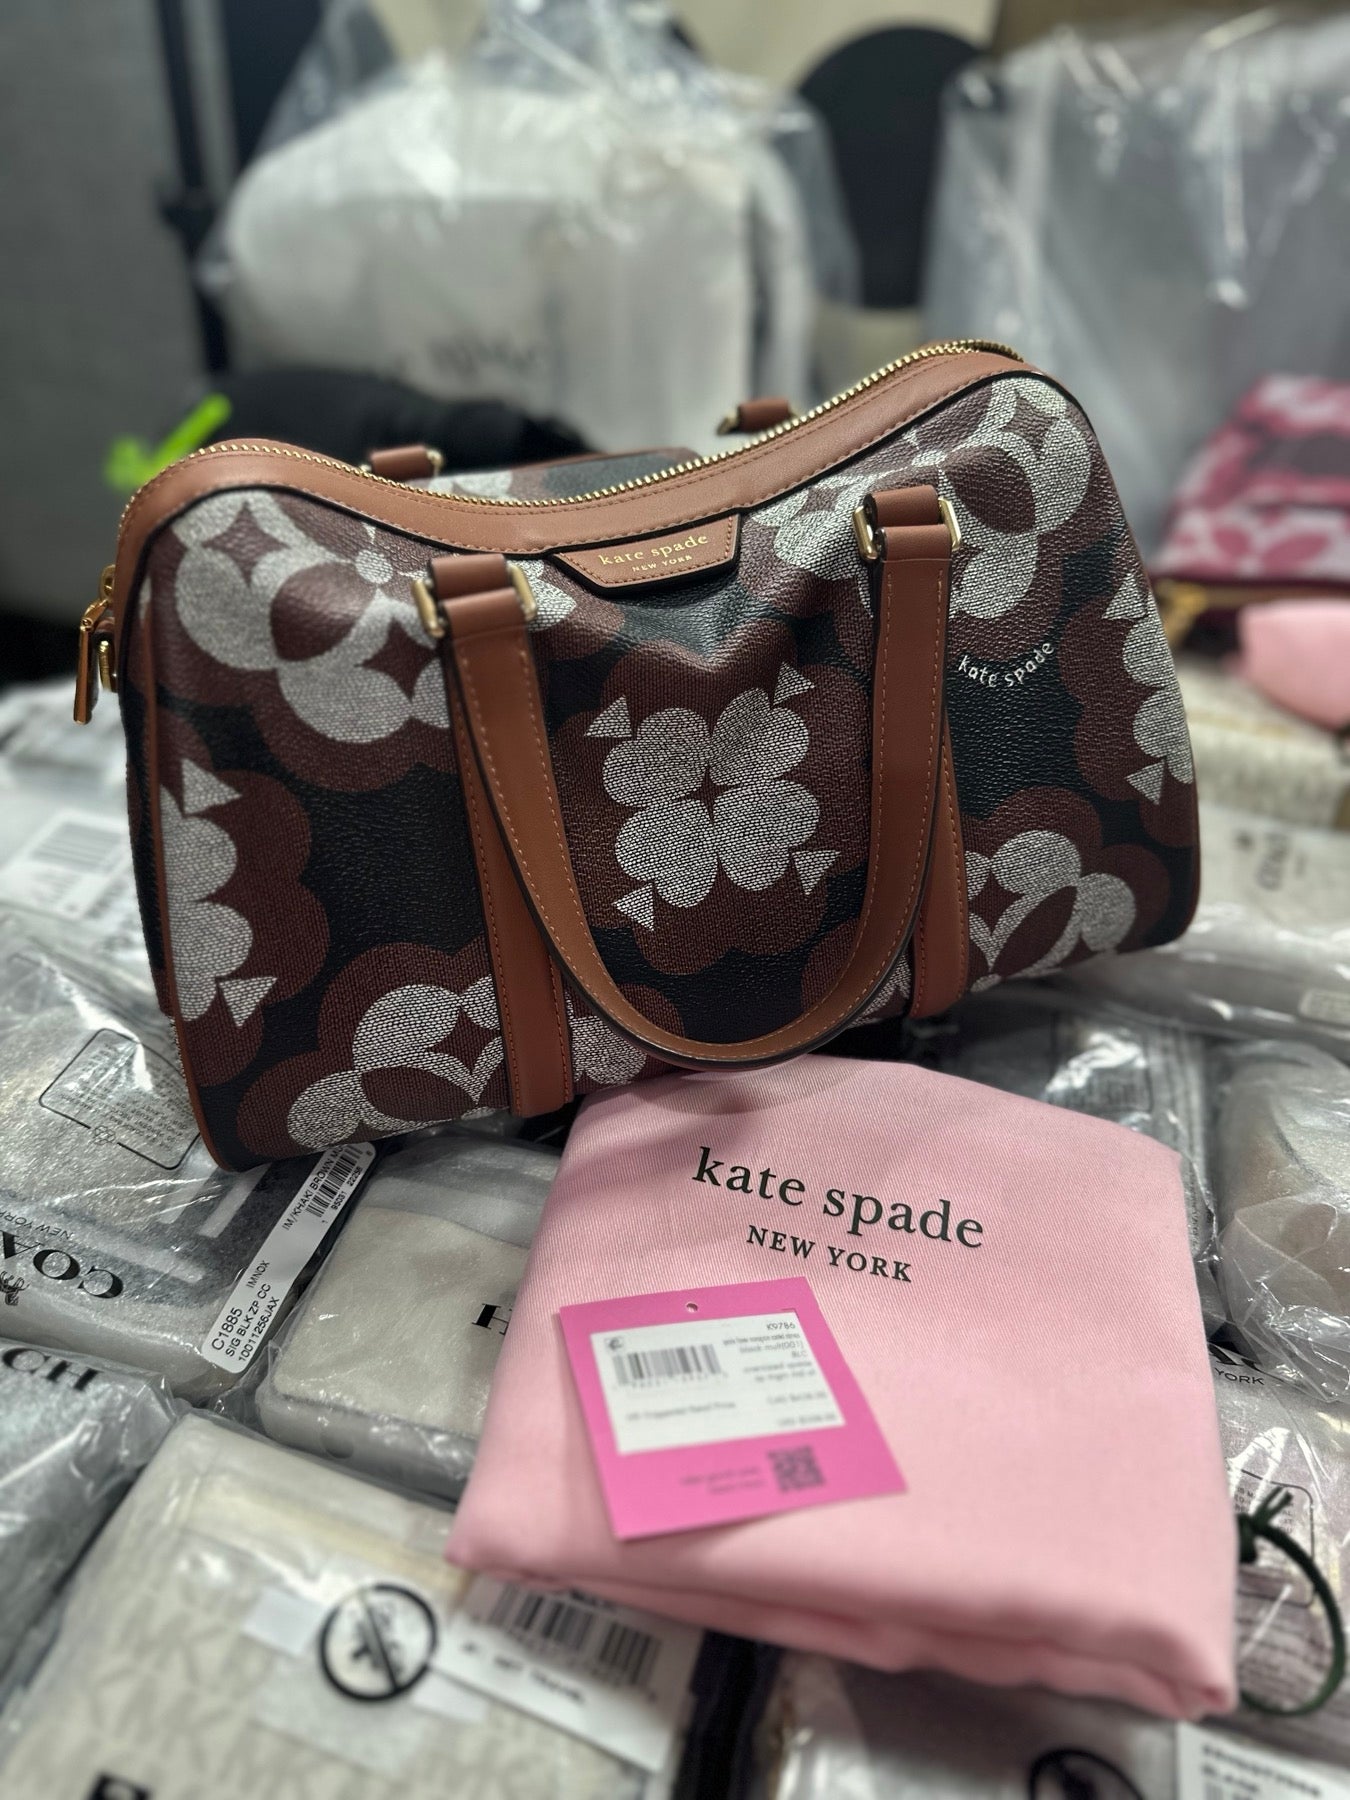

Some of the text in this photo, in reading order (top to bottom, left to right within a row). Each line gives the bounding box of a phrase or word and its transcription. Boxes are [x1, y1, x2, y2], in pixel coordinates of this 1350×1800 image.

[598, 534, 709, 566] kate spade
[632, 554, 693, 572] NEW YORK
[958, 642, 1054, 688] kate spade
[309, 1158, 335, 1191] BROWN
[691, 1145, 984, 1249] kate spade
[35, 1223, 74, 1240] NEW
[746, 1225, 913, 1283] NEW YORK
[246, 1260, 270, 1289] IMNOX
[211, 1307, 243, 1351] C1885
[225, 1337, 242, 1358] SIG
[236, 1314, 254, 1337] BLK
[248, 1300, 260, 1315] ZP
[1214, 1367, 1265, 1386] YORK
